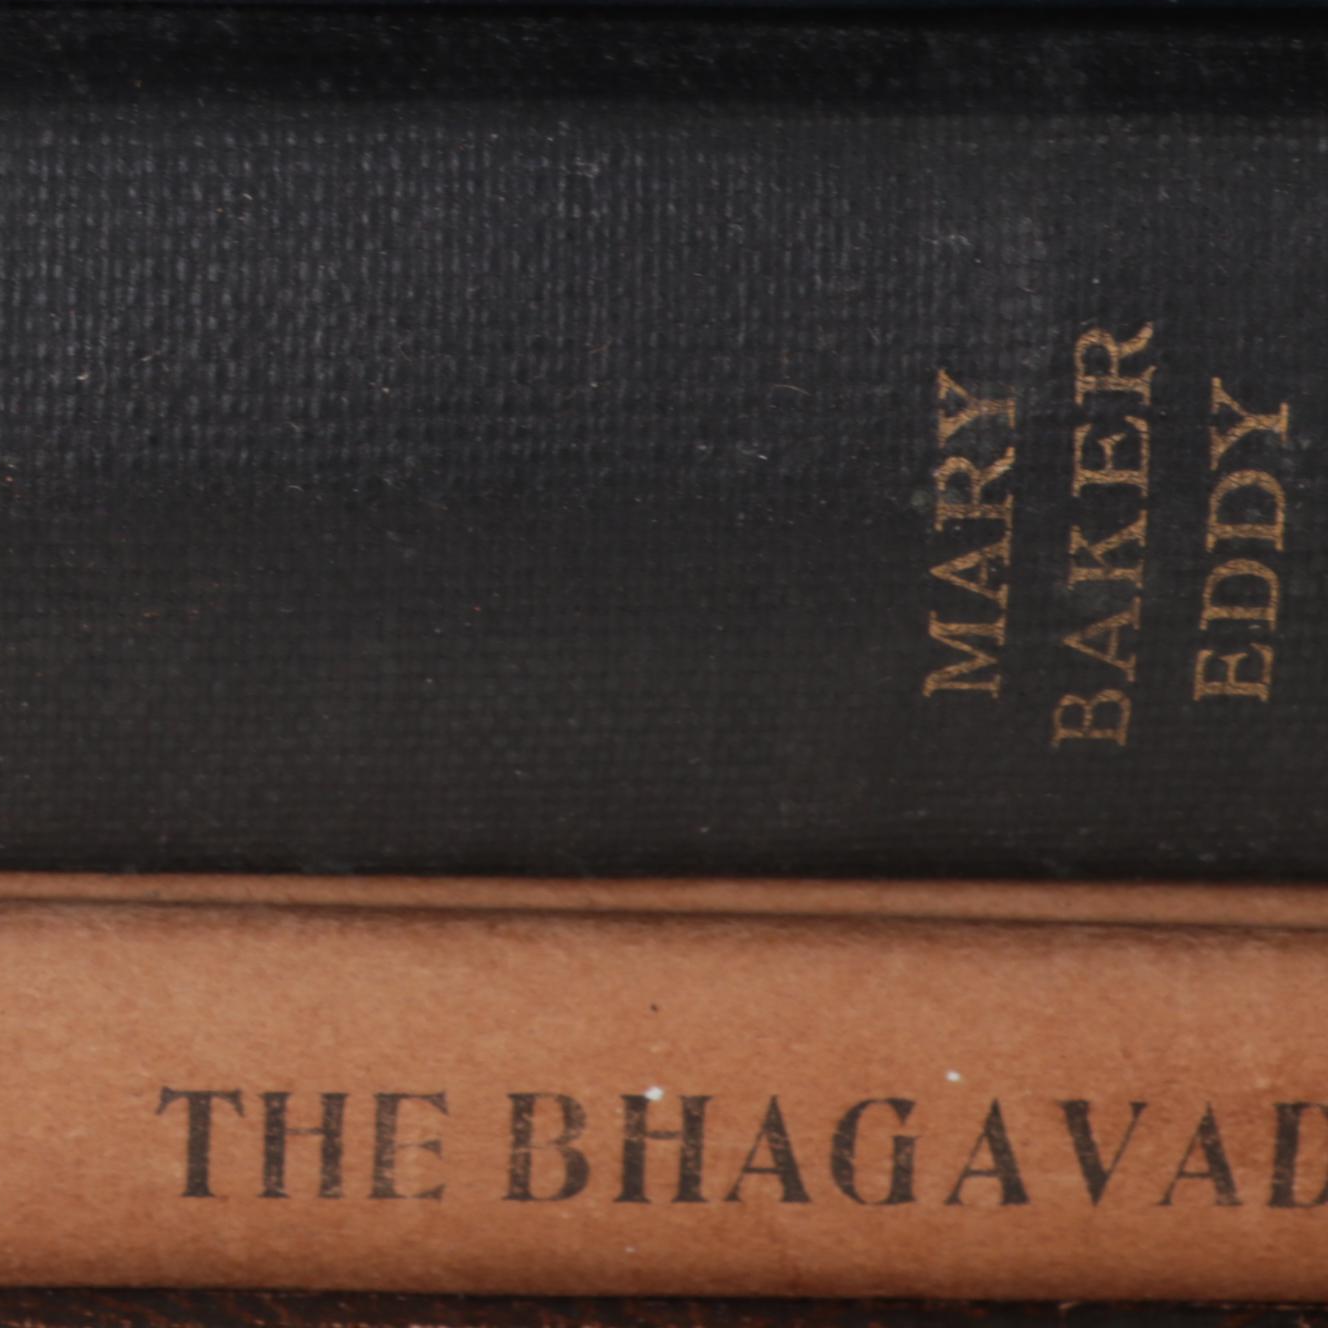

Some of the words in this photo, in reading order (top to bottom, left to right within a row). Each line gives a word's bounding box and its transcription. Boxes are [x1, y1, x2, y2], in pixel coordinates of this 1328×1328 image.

[922, 368, 1016, 699] MARY
[1051, 320, 1157, 748] BAKER
[1192, 376, 1290, 703] EDDY
[156, 1086, 450, 1200] THE
